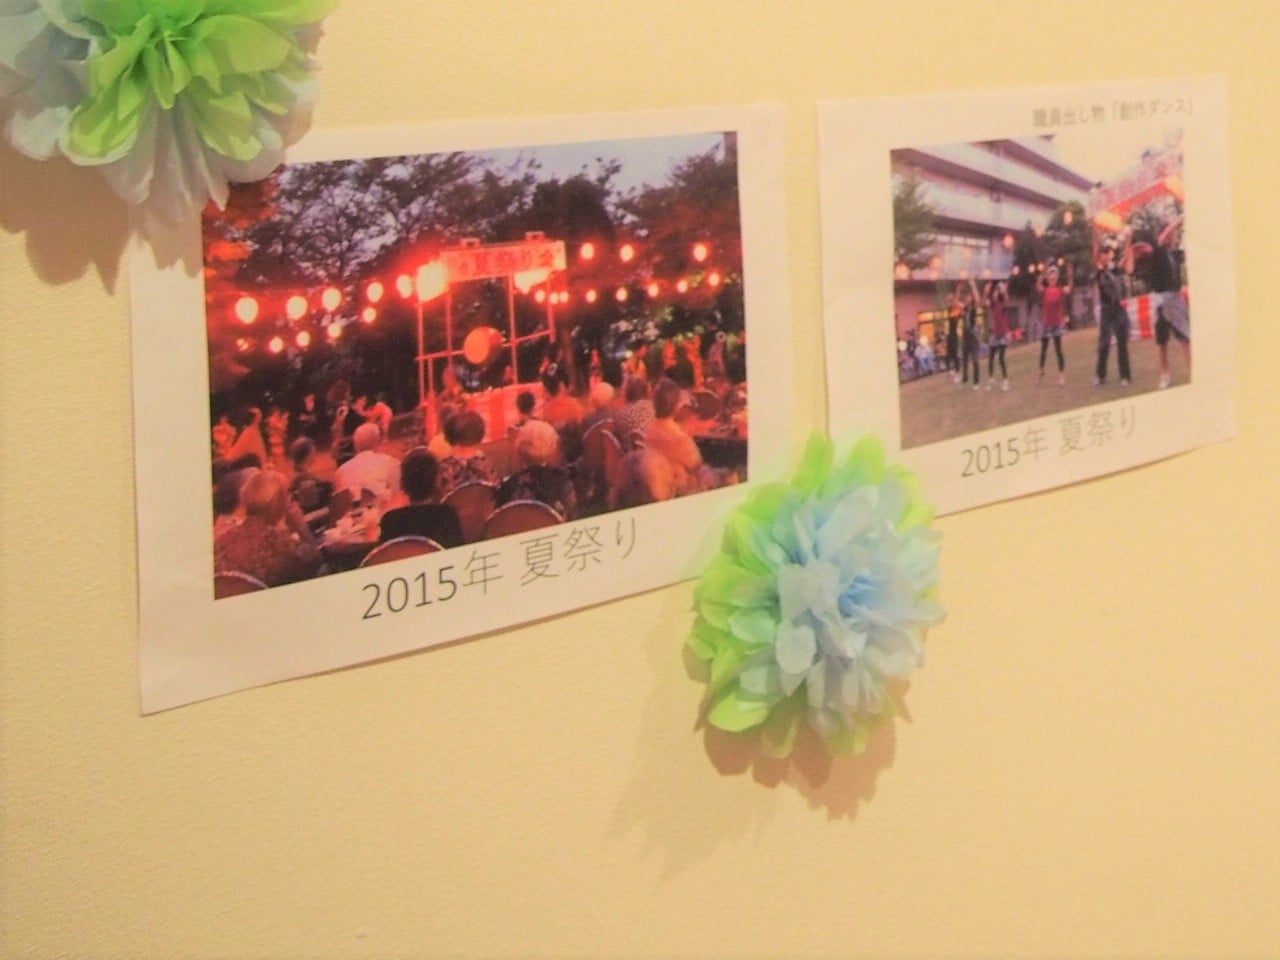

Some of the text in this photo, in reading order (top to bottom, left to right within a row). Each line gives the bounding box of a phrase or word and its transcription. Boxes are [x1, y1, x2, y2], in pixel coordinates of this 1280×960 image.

[961, 405, 1136, 478] 2015年 夏祭り
[361, 517, 637, 621] 2015年 夏祭り
